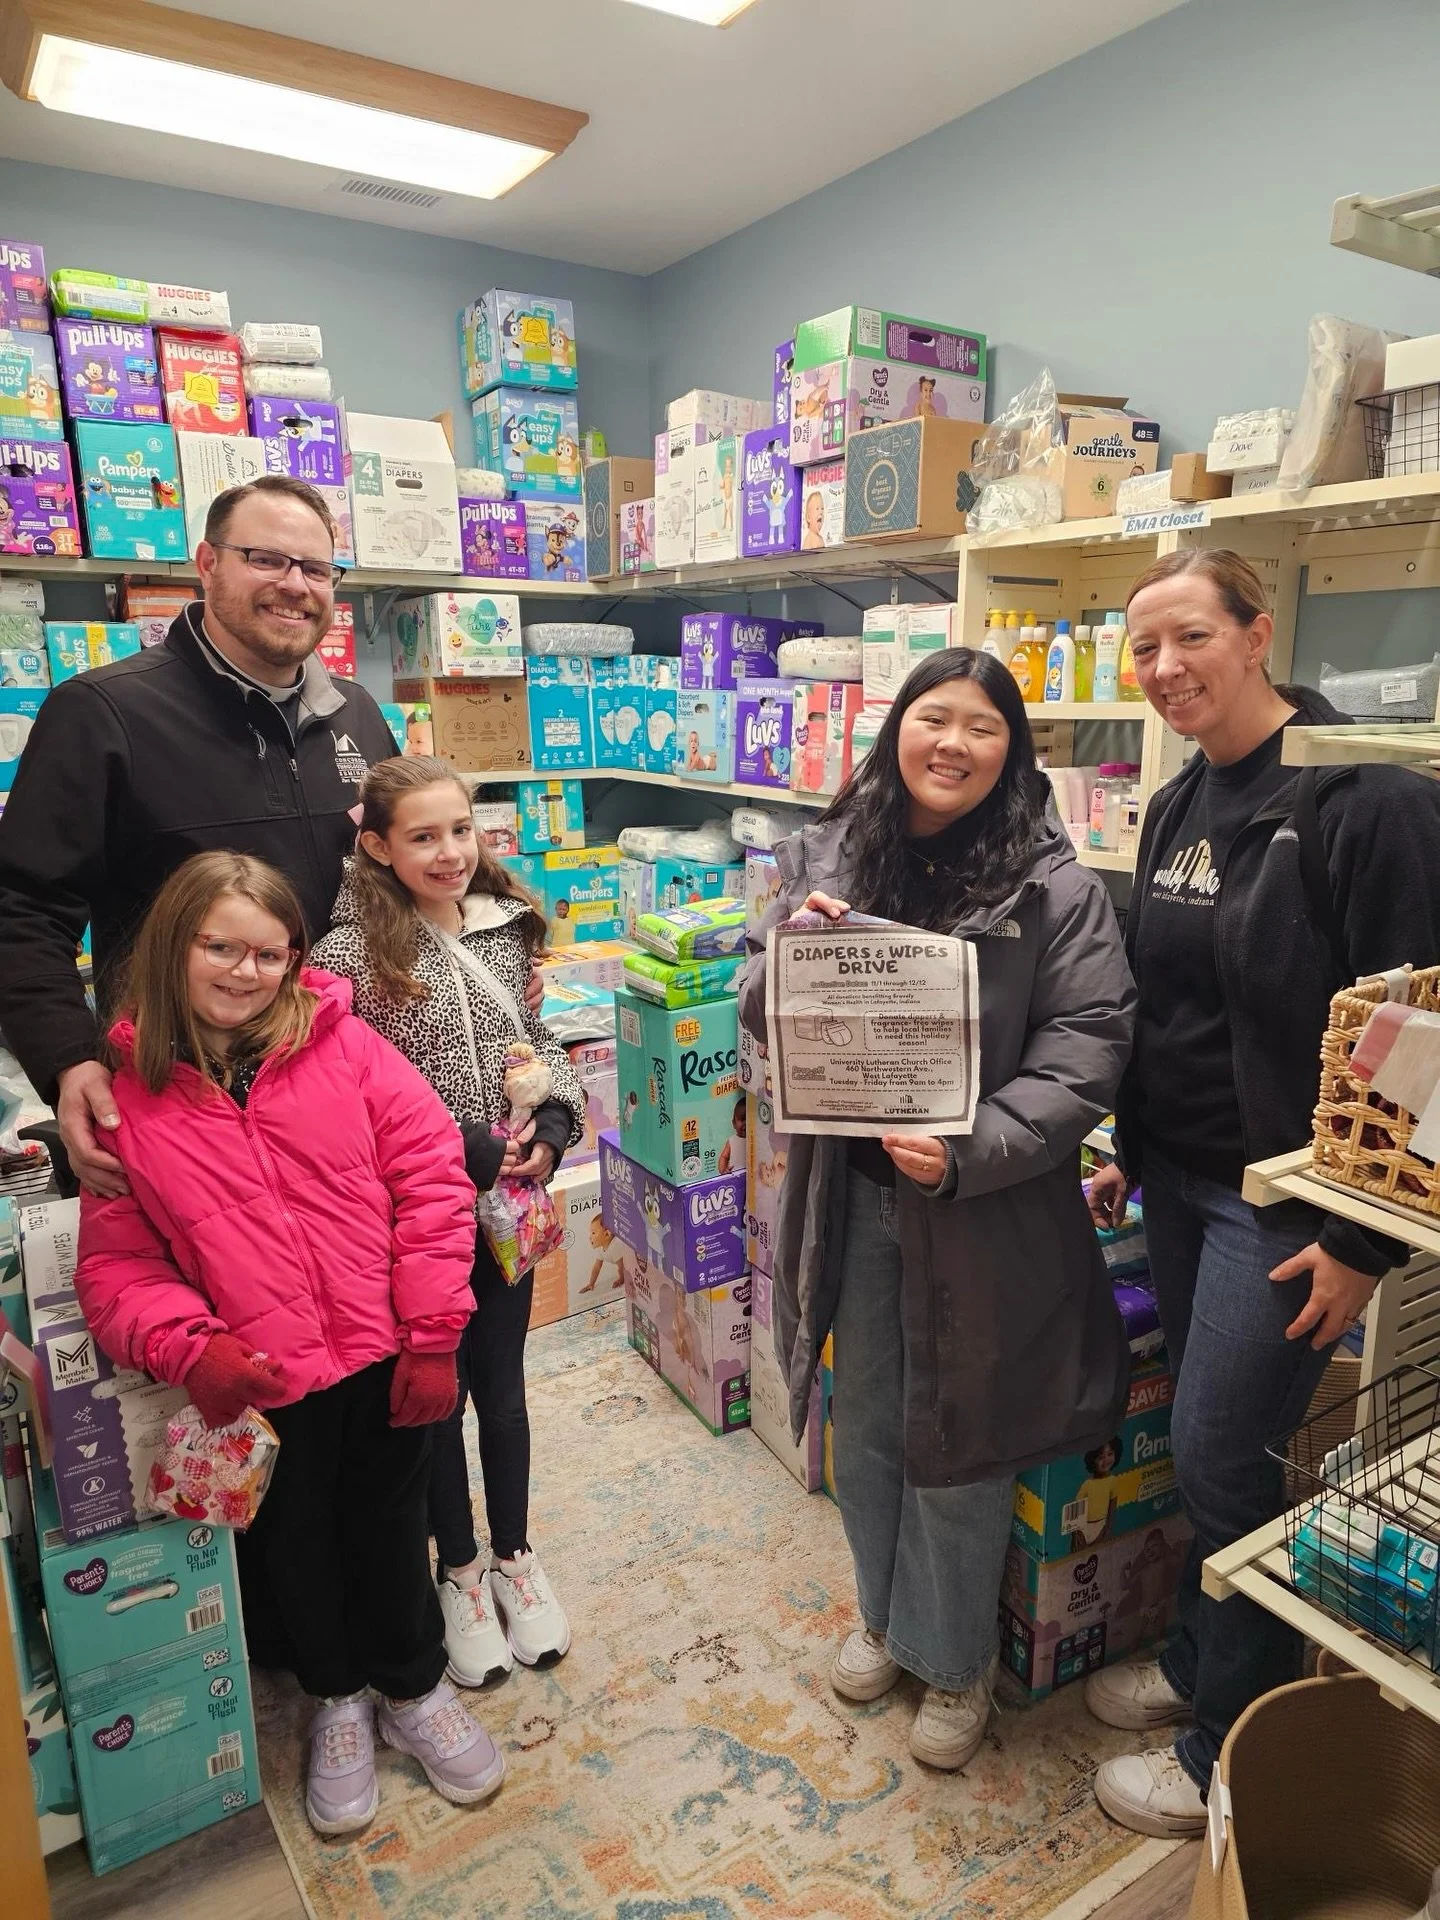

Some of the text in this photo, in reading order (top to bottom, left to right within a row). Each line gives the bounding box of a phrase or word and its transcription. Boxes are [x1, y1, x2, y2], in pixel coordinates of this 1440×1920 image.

[158, 286, 211, 302] HUGGIES
[164, 342, 238, 365] HUGGIES
[868, 395, 890, 406] Gentle
[870, 387, 889, 398] Dry &
[528, 423, 555, 436] easy
[1135, 430, 1146, 439] 48
[532, 433, 553, 445] ups
[1092, 433, 1123, 450] gentle
[657, 438, 666, 457] 5
[1229, 442, 1253, 453] Dove
[98, 455, 161, 480] Pampers
[361, 459, 375, 478] 4
[746, 448, 772, 484] Luvs
[385, 469, 423, 480] DIAPERS
[806, 464, 845, 487] HUGGIE
[1097, 480, 1105, 492] 6
[1248, 479, 1270, 490] Dove
[1160, 511, 1204, 527] Closet
[684, 621, 702, 643] Luvs
[732, 621, 766, 652] Luvs
[345, 663, 354, 673] 2
[433, 682, 490, 696] HUGGIES
[743, 687, 779, 696] ONE MONTH
[722, 695, 727, 706] 2
[558, 709, 564, 718] 2
[745, 713, 781, 756] Luvs
[516, 750, 526, 762] 2
[779, 752, 785, 764] 2
[559, 856, 581, 865] SAVE
[570, 885, 613, 901] Pampers
[793, 946, 871, 961] DIAPERS
[889, 945, 948, 959] WIPES
[838, 959, 899, 975] DRIVE
[883, 980, 908, 988] through
[908, 979, 926, 987] 12/12
[907, 1013, 938, 1021] diapers
[931, 1020, 954, 1028] wipes
[675, 1021, 700, 1038] FREE
[882, 1026, 900, 1034] help
[920, 1032, 950, 1041] holiday
[829, 1057, 952, 1067] University Lutheran Church Office
[861, 1065, 912, 1073] Northwestern
[680, 1049, 738, 1094] Rasc
[881, 1073, 918, 1081] Lafayette
[716, 1079, 739, 1096] DIAPE
[829, 1079, 954, 1088] Tuesday Friday from 9am to 4pm
[884, 1107, 930, 1115] LUTHERAN
[686, 1119, 697, 1131] 12
[704, 1150, 716, 1160] 96
[606, 1149, 633, 1184] Luvs
[570, 1199, 602, 1215] DIAPE
[690, 1186, 735, 1226] Luvs
[53, 1231, 73, 1263] WIPES
[699, 1273, 705, 1281] 2
[756, 1278, 766, 1300] 5
[55, 1366, 95, 1382] Member's
[65, 1375, 87, 1386] Mark
[76, 1525, 94, 1538] 99%
[186, 1546, 219, 1566] Do Not
[190, 1557, 217, 1573] Flush
[70, 1563, 106, 1587] Parent's
[79, 1575, 104, 1592] CHOICE
[1070, 1583, 1099, 1602] Dry &
[1067, 1592, 1101, 1613] Gentle
[1073, 1656, 1084, 1673] 6
[207, 1696, 239, 1714] Do Not
[211, 1706, 237, 1721] Flush
[98, 1720, 132, 1745] Parent's
[107, 1732, 131, 1749] CHOICE
